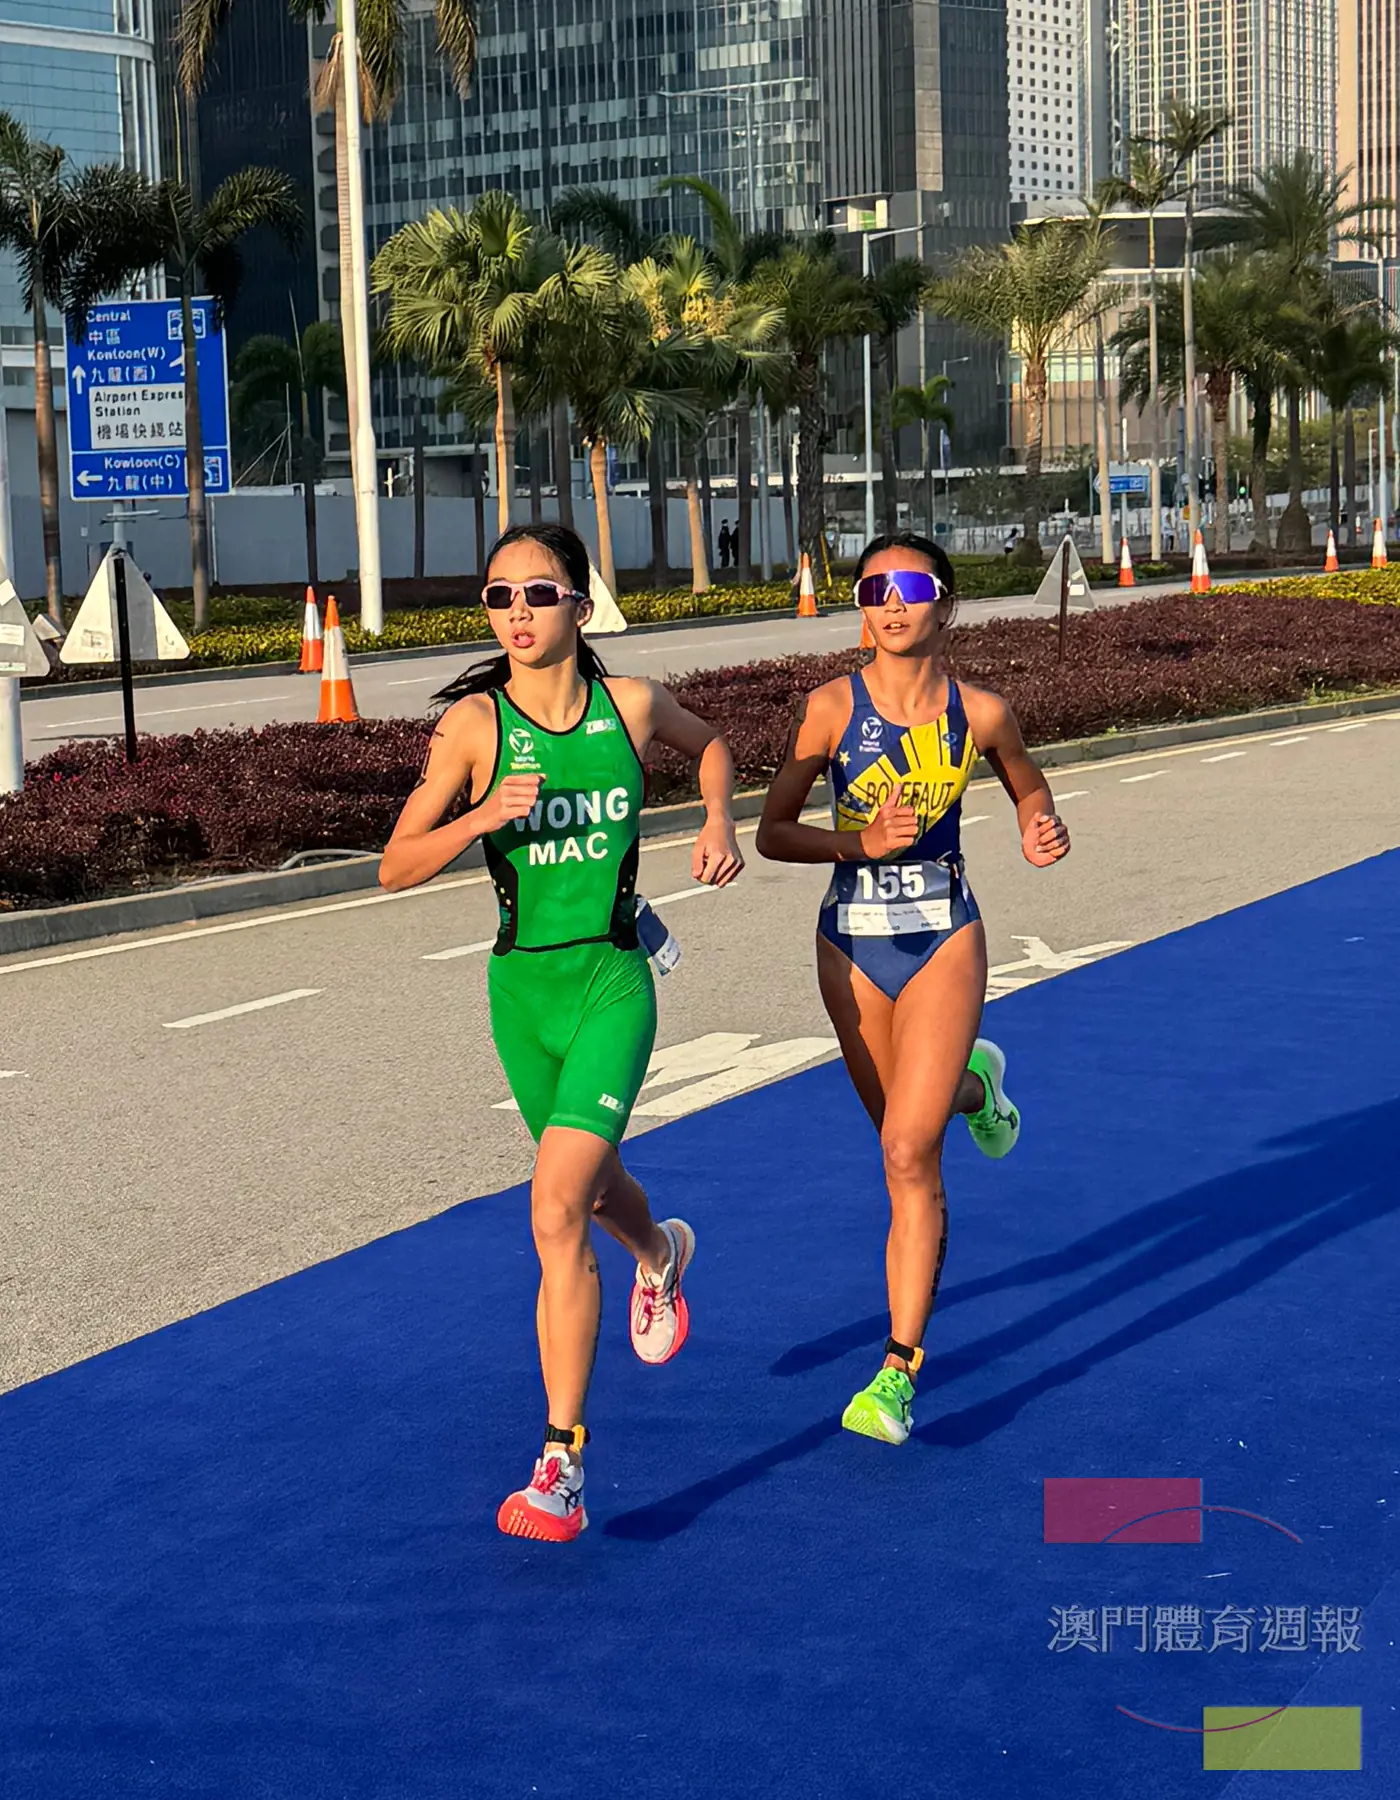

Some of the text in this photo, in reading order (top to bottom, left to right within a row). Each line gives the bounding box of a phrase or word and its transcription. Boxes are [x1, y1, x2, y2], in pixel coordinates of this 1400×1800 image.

[86, 310, 131, 323] Central
[94, 387, 184, 404] Airport Expres
[95, 405, 141, 418] Station
[104, 454, 181, 469] Kowloon(C)
[513, 787, 629, 832] WONG
[528, 831, 609, 866] MAC
[857, 865, 925, 900] 155
